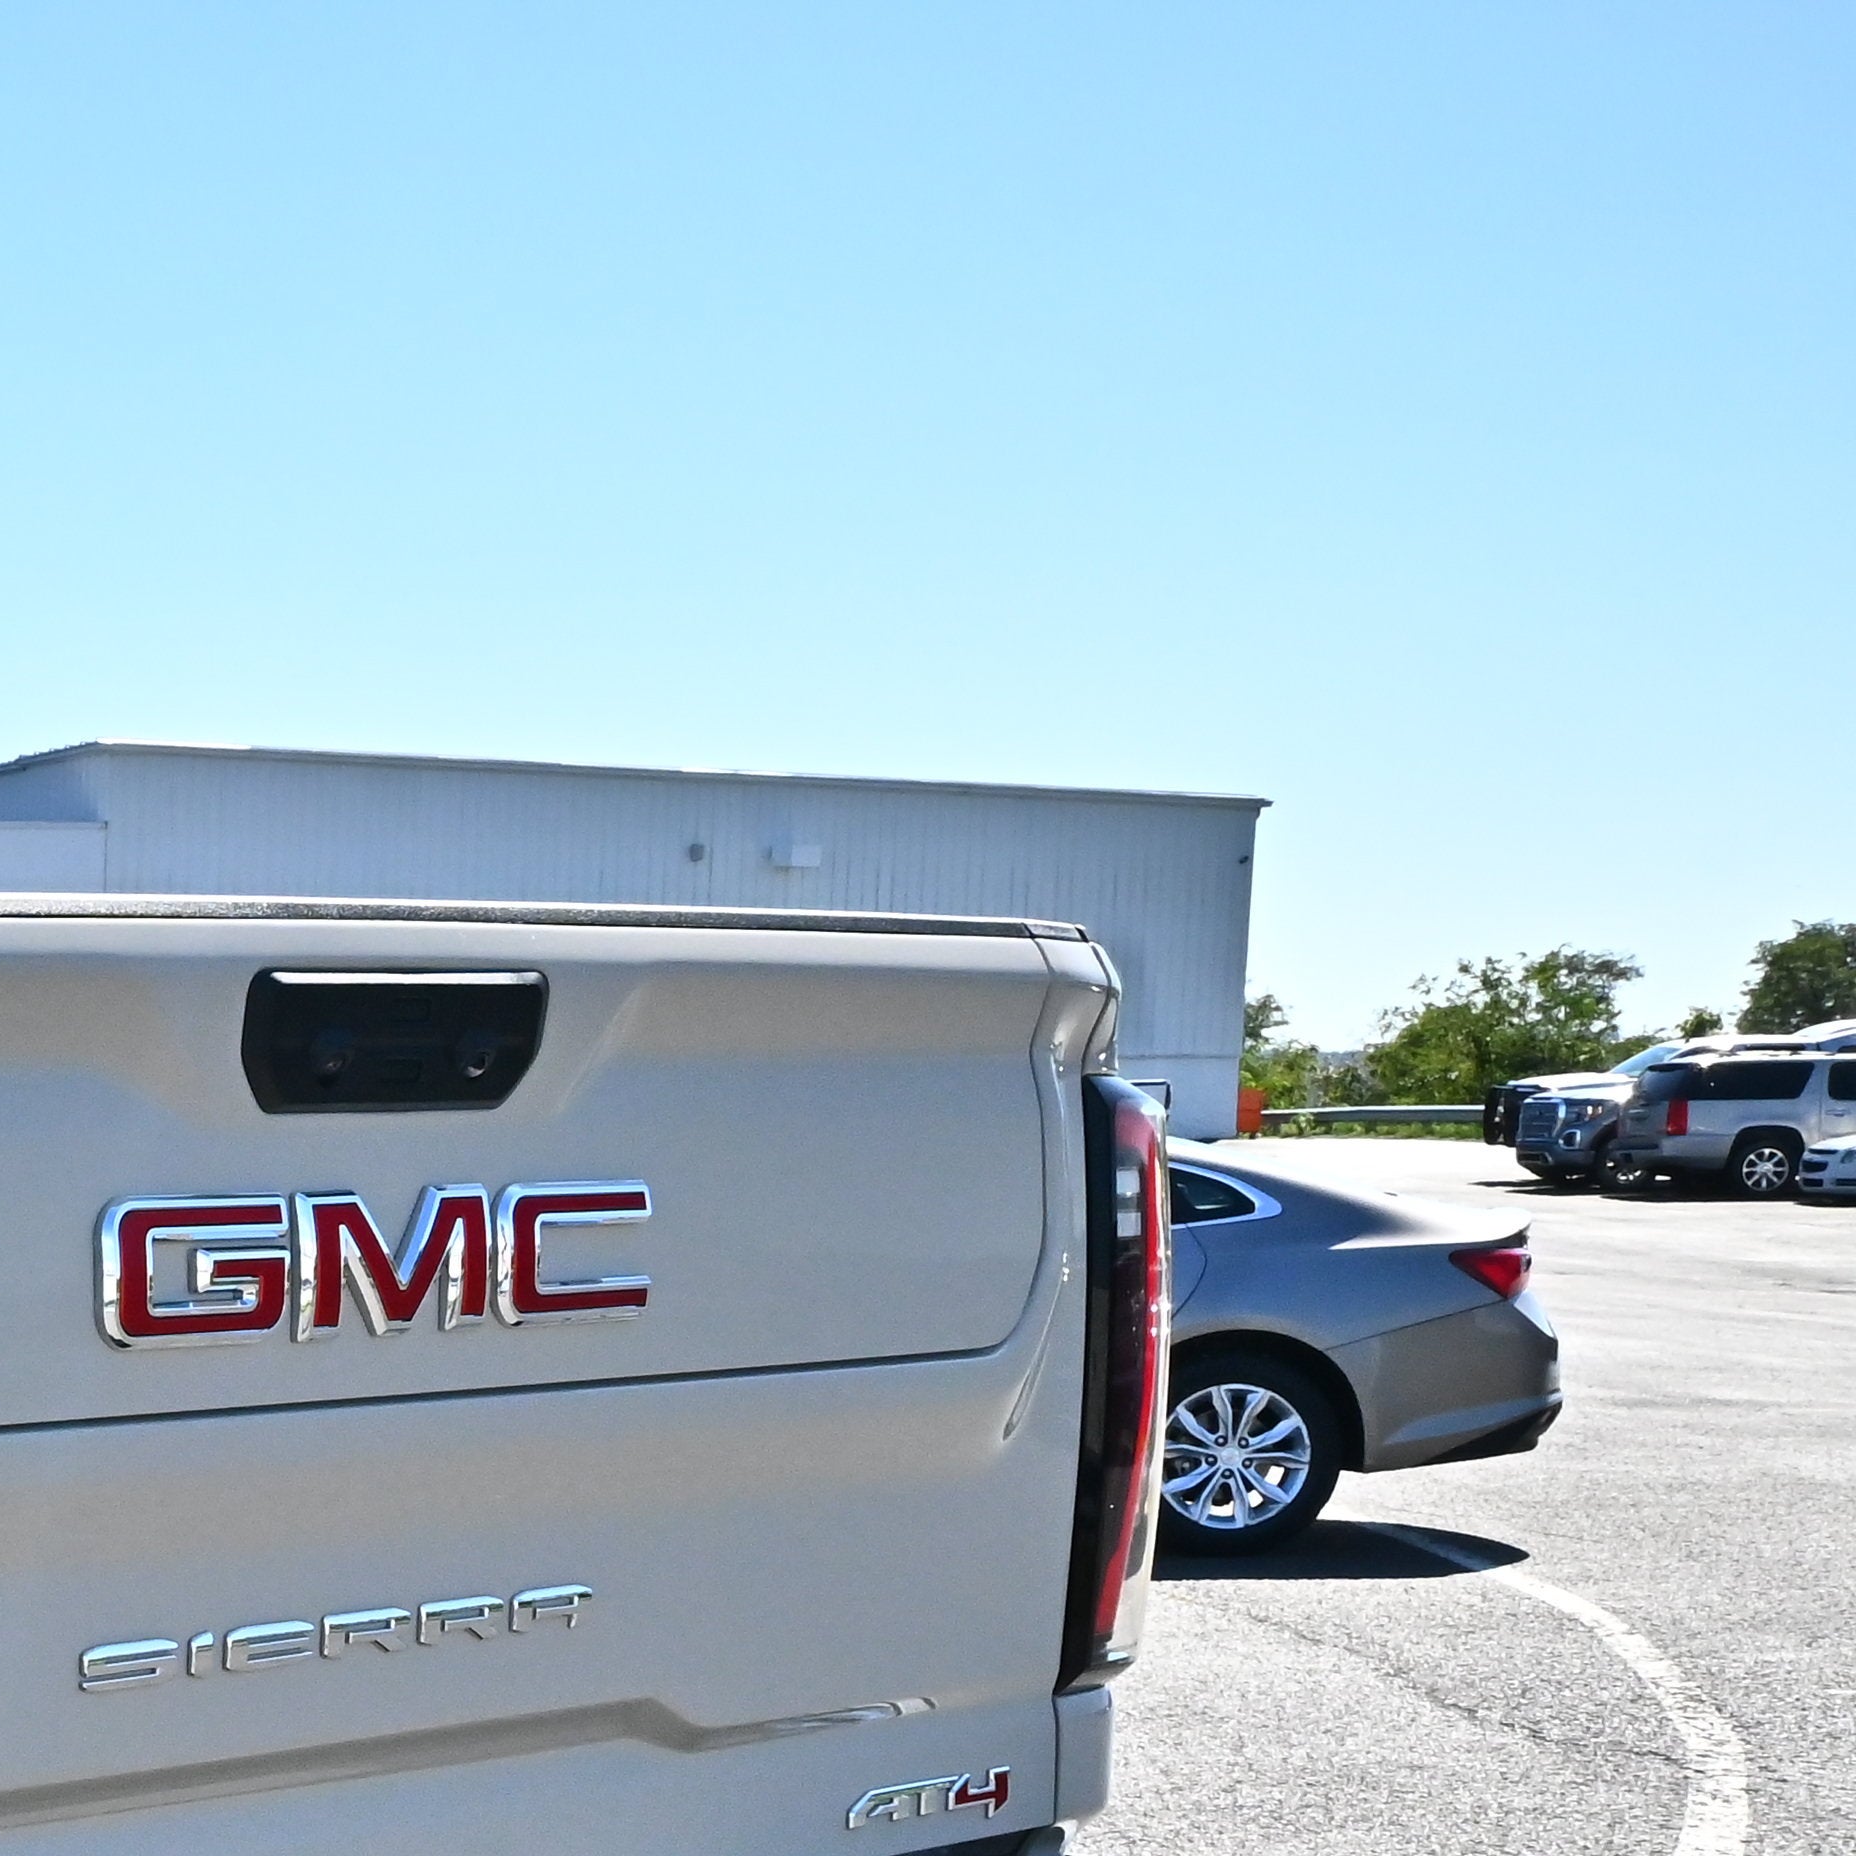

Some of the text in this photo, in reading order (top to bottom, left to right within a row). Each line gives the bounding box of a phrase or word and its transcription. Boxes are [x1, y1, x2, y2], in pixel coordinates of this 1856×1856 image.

[95, 1179, 653, 1351] GMC
[79, 1584, 592, 1692] SIERRA
[847, 1765, 1010, 1830] AT4
